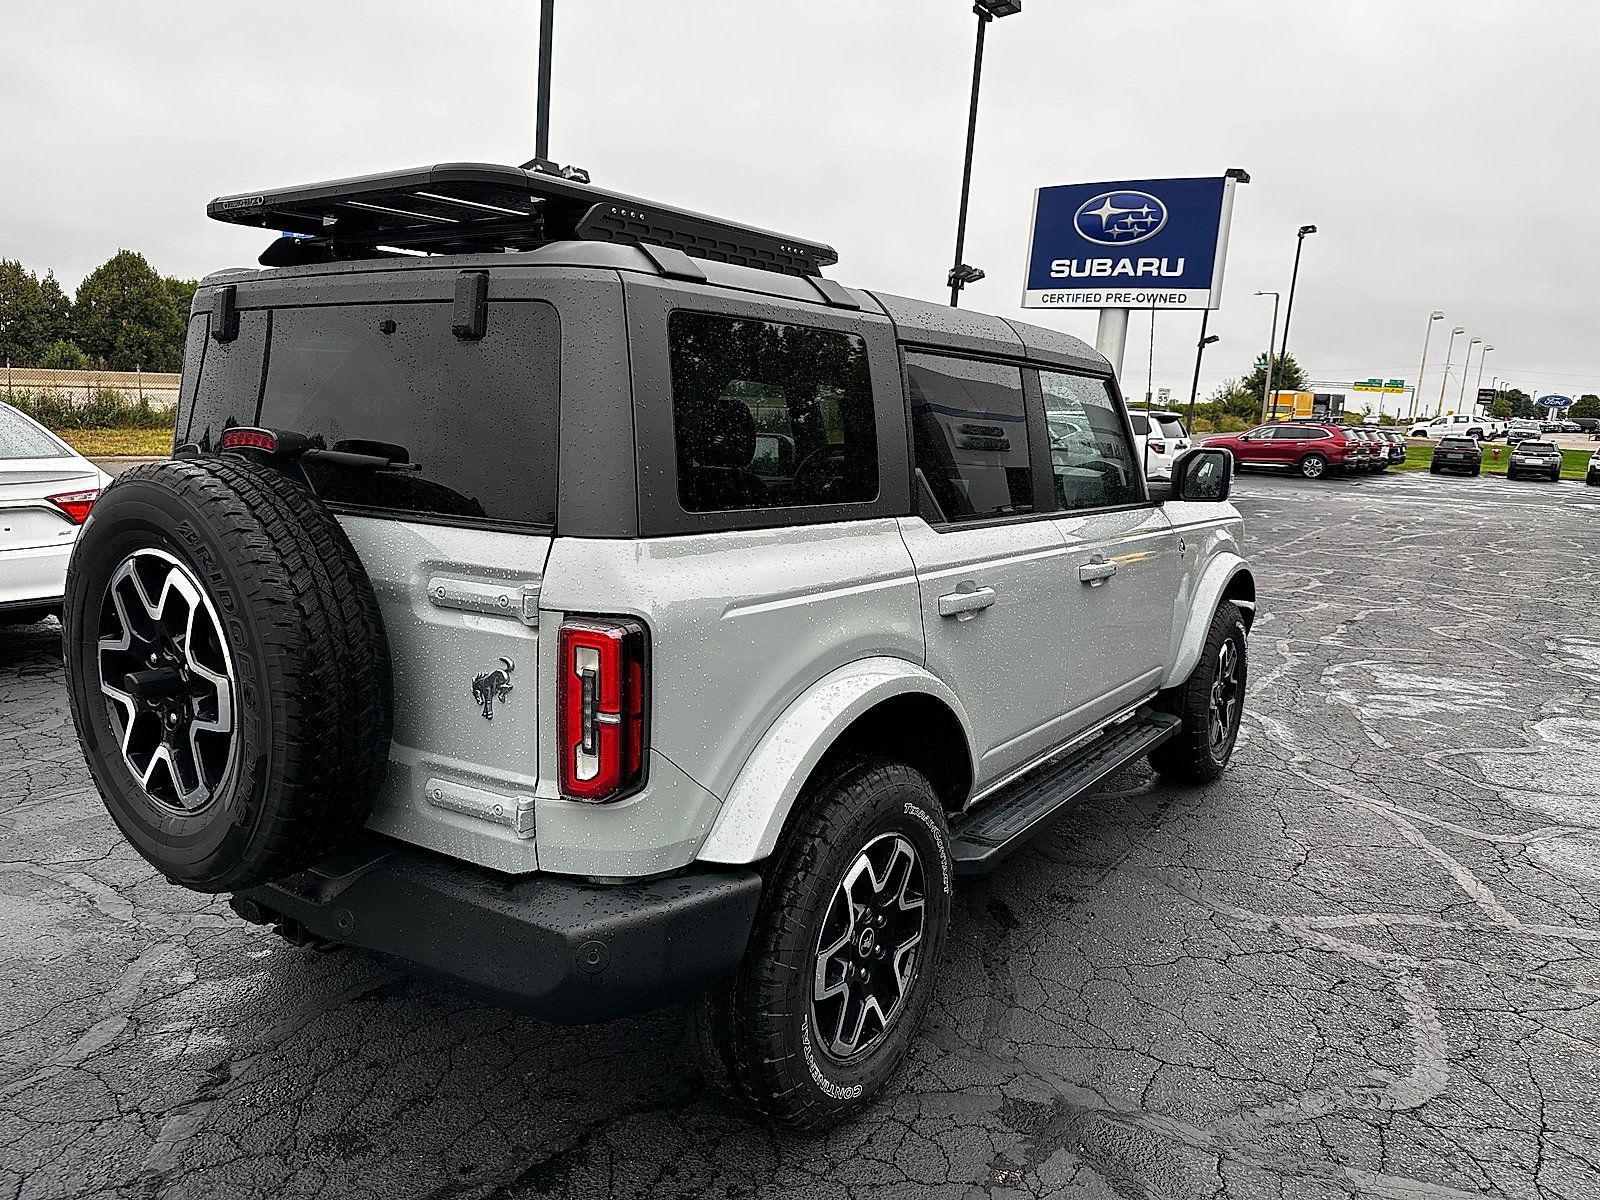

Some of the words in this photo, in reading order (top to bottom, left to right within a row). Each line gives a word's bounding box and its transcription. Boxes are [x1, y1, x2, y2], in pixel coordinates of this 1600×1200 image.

[1050, 257, 1185, 278] SUBARU
[1041, 293, 1102, 304] CERTIFIED
[1105, 293, 1188, 304] PRE-OWNED
[1544, 396, 1566, 406] Ford
[175, 518, 262, 827] BRIDGESTONE
[801, 1013, 863, 1100] CONTINENTAL
